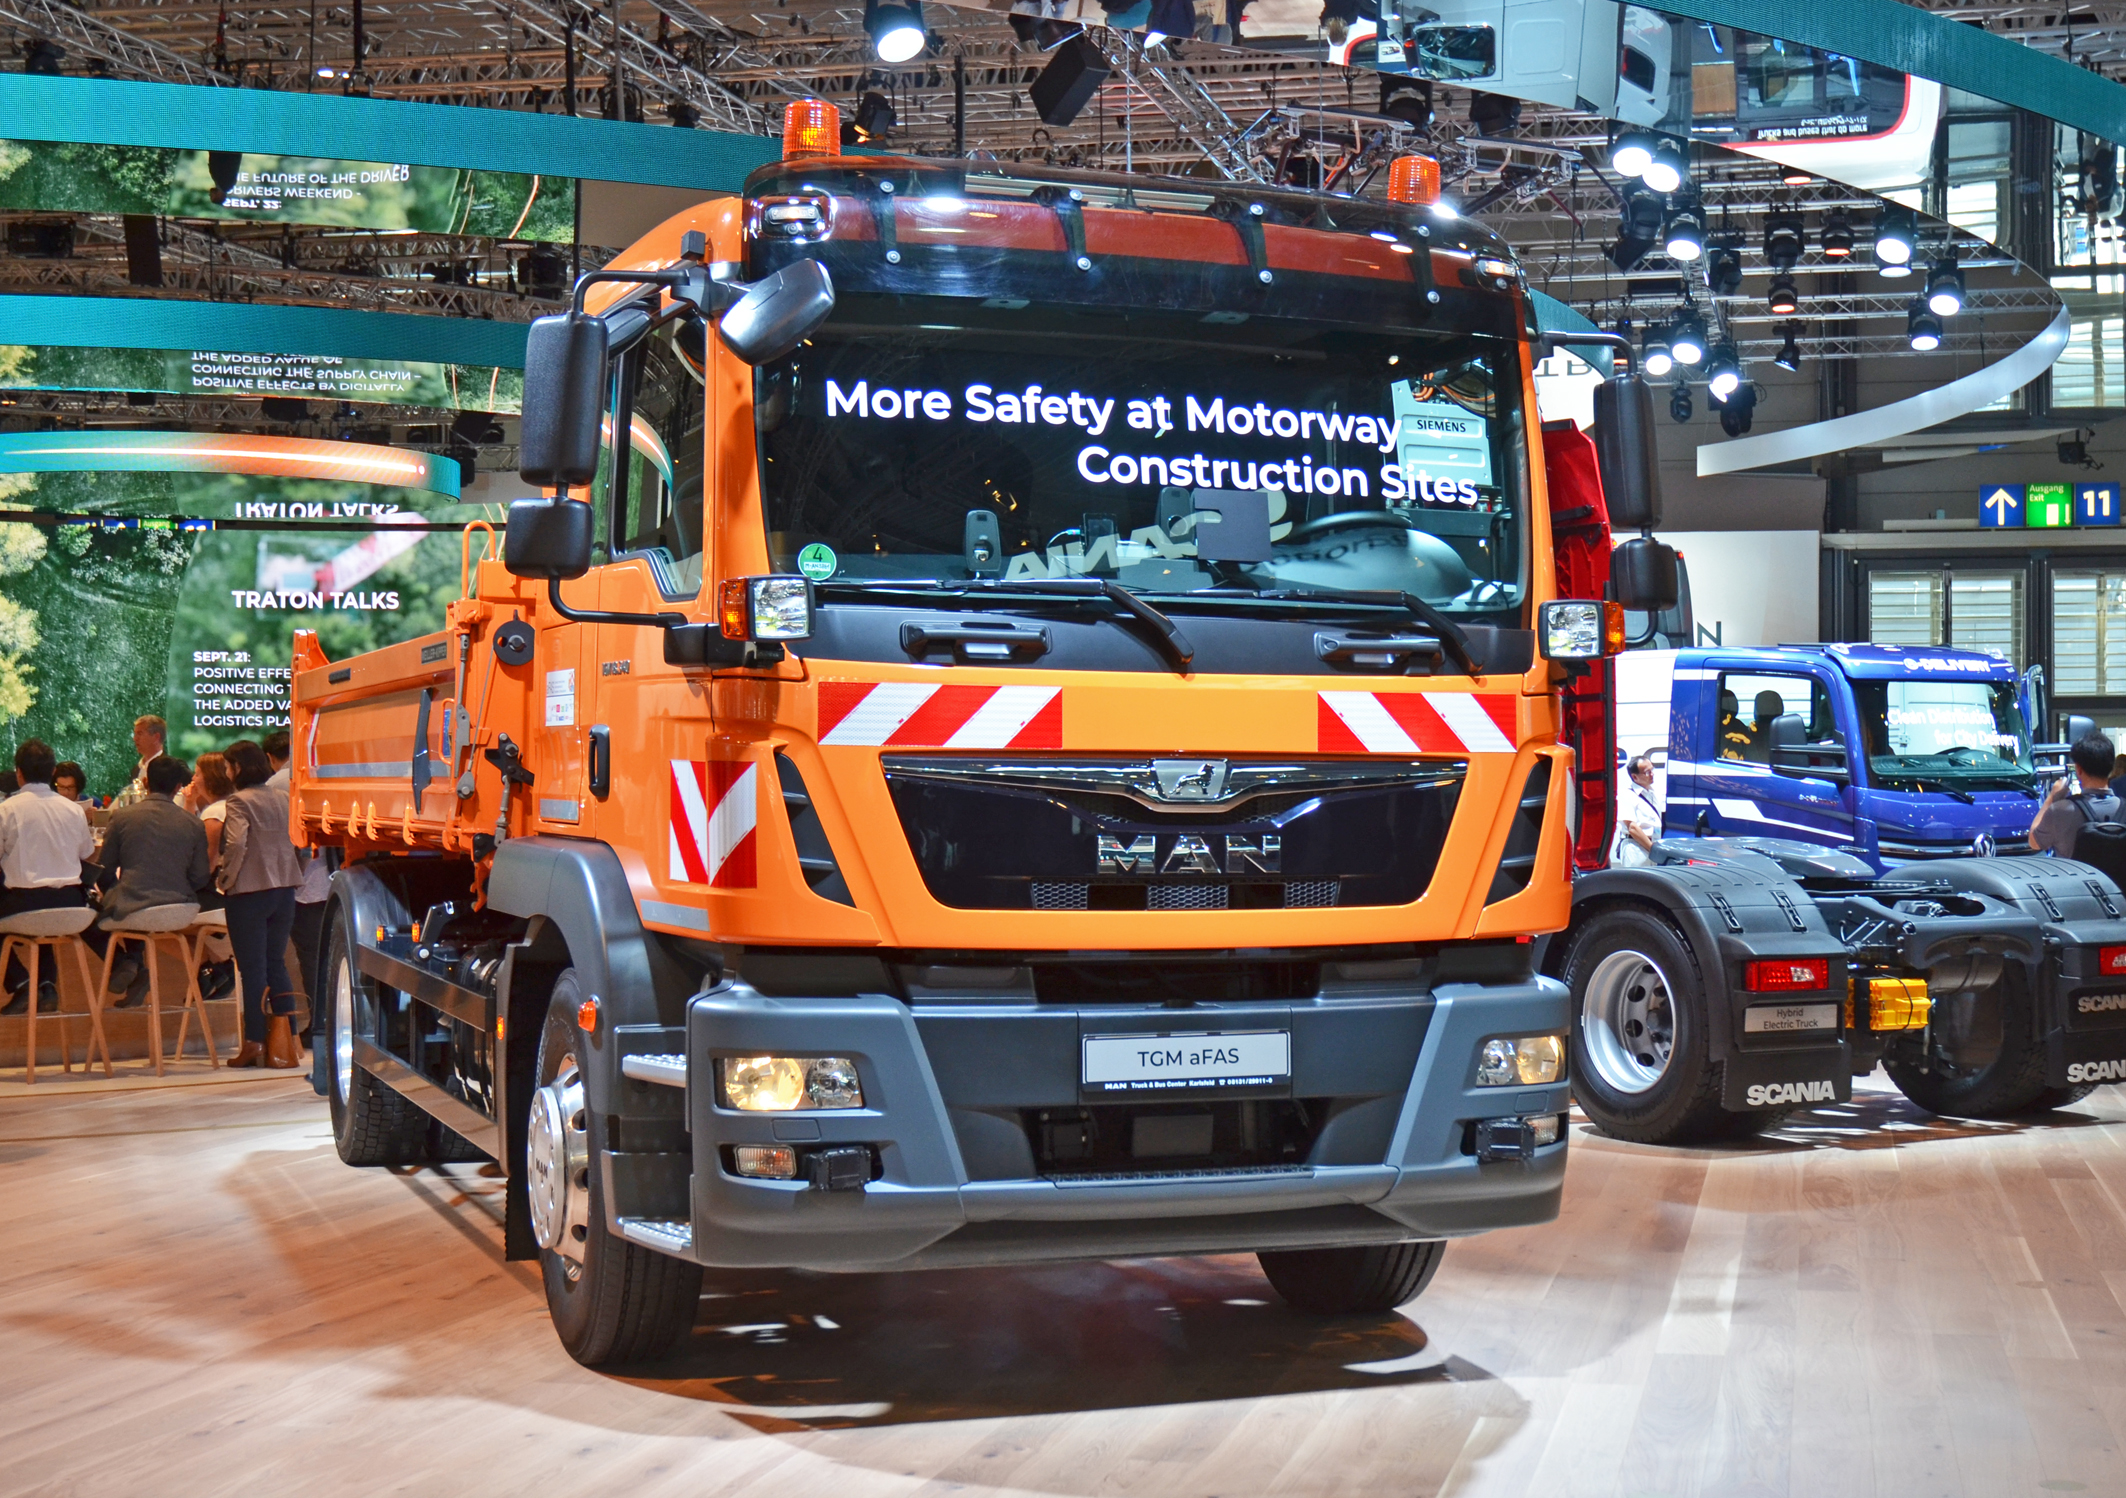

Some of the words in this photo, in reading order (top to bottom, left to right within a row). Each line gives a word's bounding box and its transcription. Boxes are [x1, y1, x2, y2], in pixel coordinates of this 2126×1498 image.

[825, 380, 952, 420] More
[964, 383, 1115, 436] Safety
[1127, 397, 1174, 432] at
[1185, 395, 1402, 454] Motorway
[1416, 419, 1467, 433] SIEMENS
[1077, 445, 1369, 497] Construction
[1381, 464, 1478, 507] Sites
[2029, 484, 2065, 494] Ausgang
[2029, 493, 2045, 502] Exit
[2083, 490, 2110, 517] 11
[813, 547, 823, 562] 4
[231, 590, 324, 609] TRATON
[329, 591, 400, 610] TALKS
[193, 651, 232, 662] SEPT.
[234, 651, 251, 663] 21:
[194, 667, 255, 679] POSITIVE
[193, 683, 284, 695] CONNECTING
[193, 699, 221, 711] THE
[223, 699, 274, 711] ADDED
[194, 715, 263, 727] LOGISTICS
[1887, 709, 1926, 725] Clean
[1927, 707, 1996, 729] Distribution
[1934, 730, 1952, 746] for
[1954, 730, 1977, 748] City
[1978, 730, 2020, 757] Delivery
[1097, 835, 1281, 874] MAN
[1776, 1008, 1804, 1019] Hybrid
[1763, 1020, 1793, 1030] Electric
[1796, 1019, 1818, 1028] Truck
[1137, 1050, 1182, 1067] TGM
[1189, 1048, 1239, 1066] aFAS
[1104, 1082, 1127, 1090] MAN
[1131, 1081, 1148, 1089] Truck
[1166, 1080, 1187, 1088] Center
[1188, 1079, 1215, 1087] Karlsfeld
[1746, 1080, 1836, 1106] SCANIA
